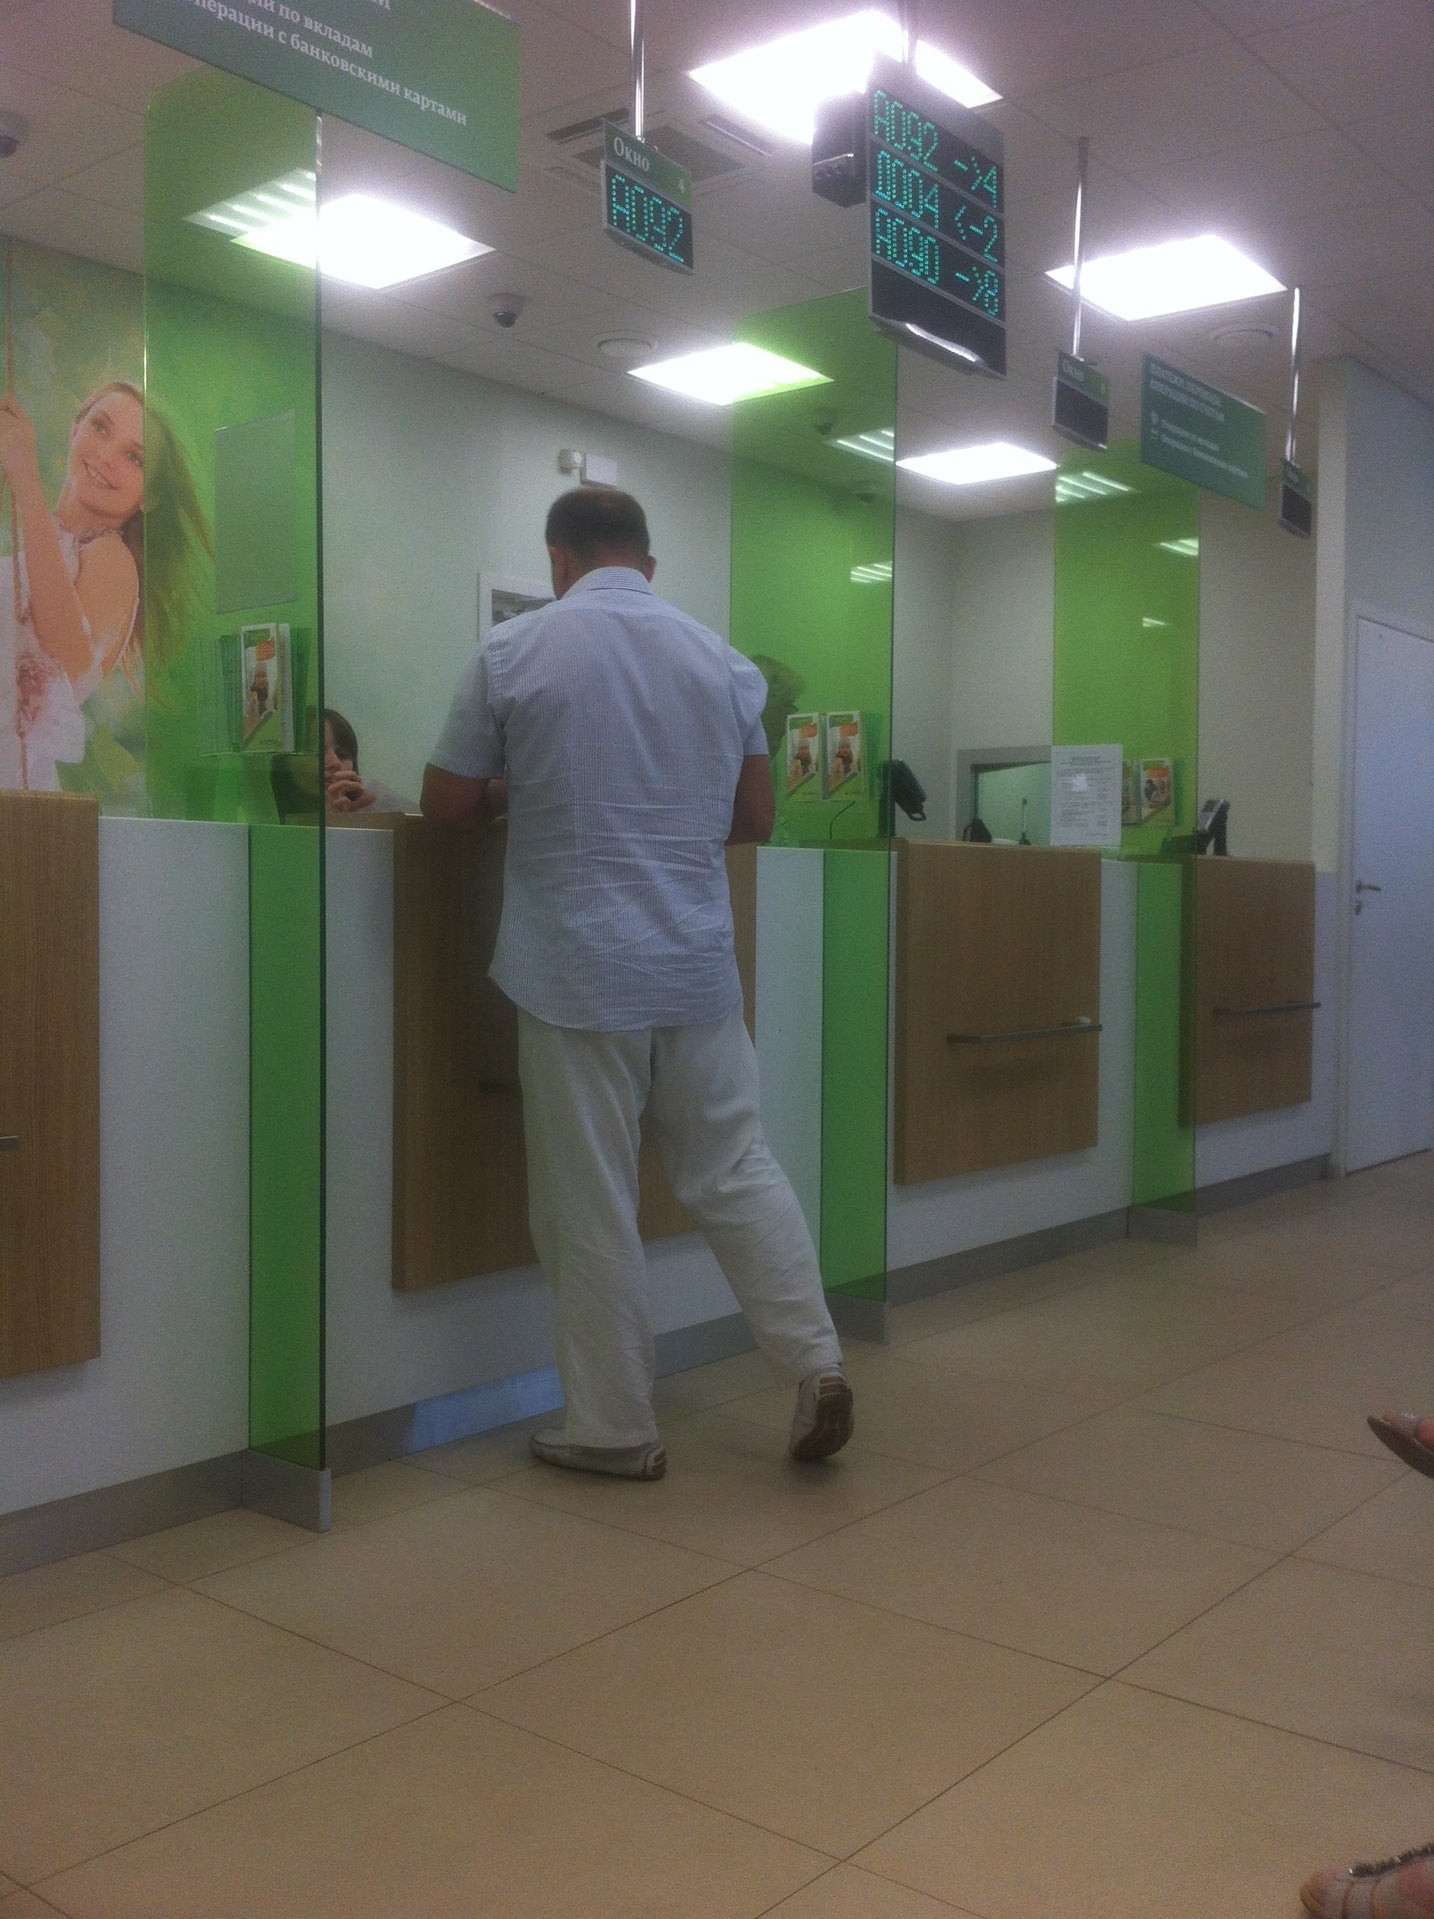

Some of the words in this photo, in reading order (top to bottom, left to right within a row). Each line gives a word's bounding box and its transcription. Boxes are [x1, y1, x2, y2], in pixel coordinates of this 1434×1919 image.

[279, 5, 301, 23] по
[303, 15, 373, 59] вкладам
[189, 0, 275, 39] перации
[278, 31, 288, 44] с
[290, 33, 401, 97] банковскими
[403, 86, 467, 126] картами
[613, 136, 651, 172] Окно
